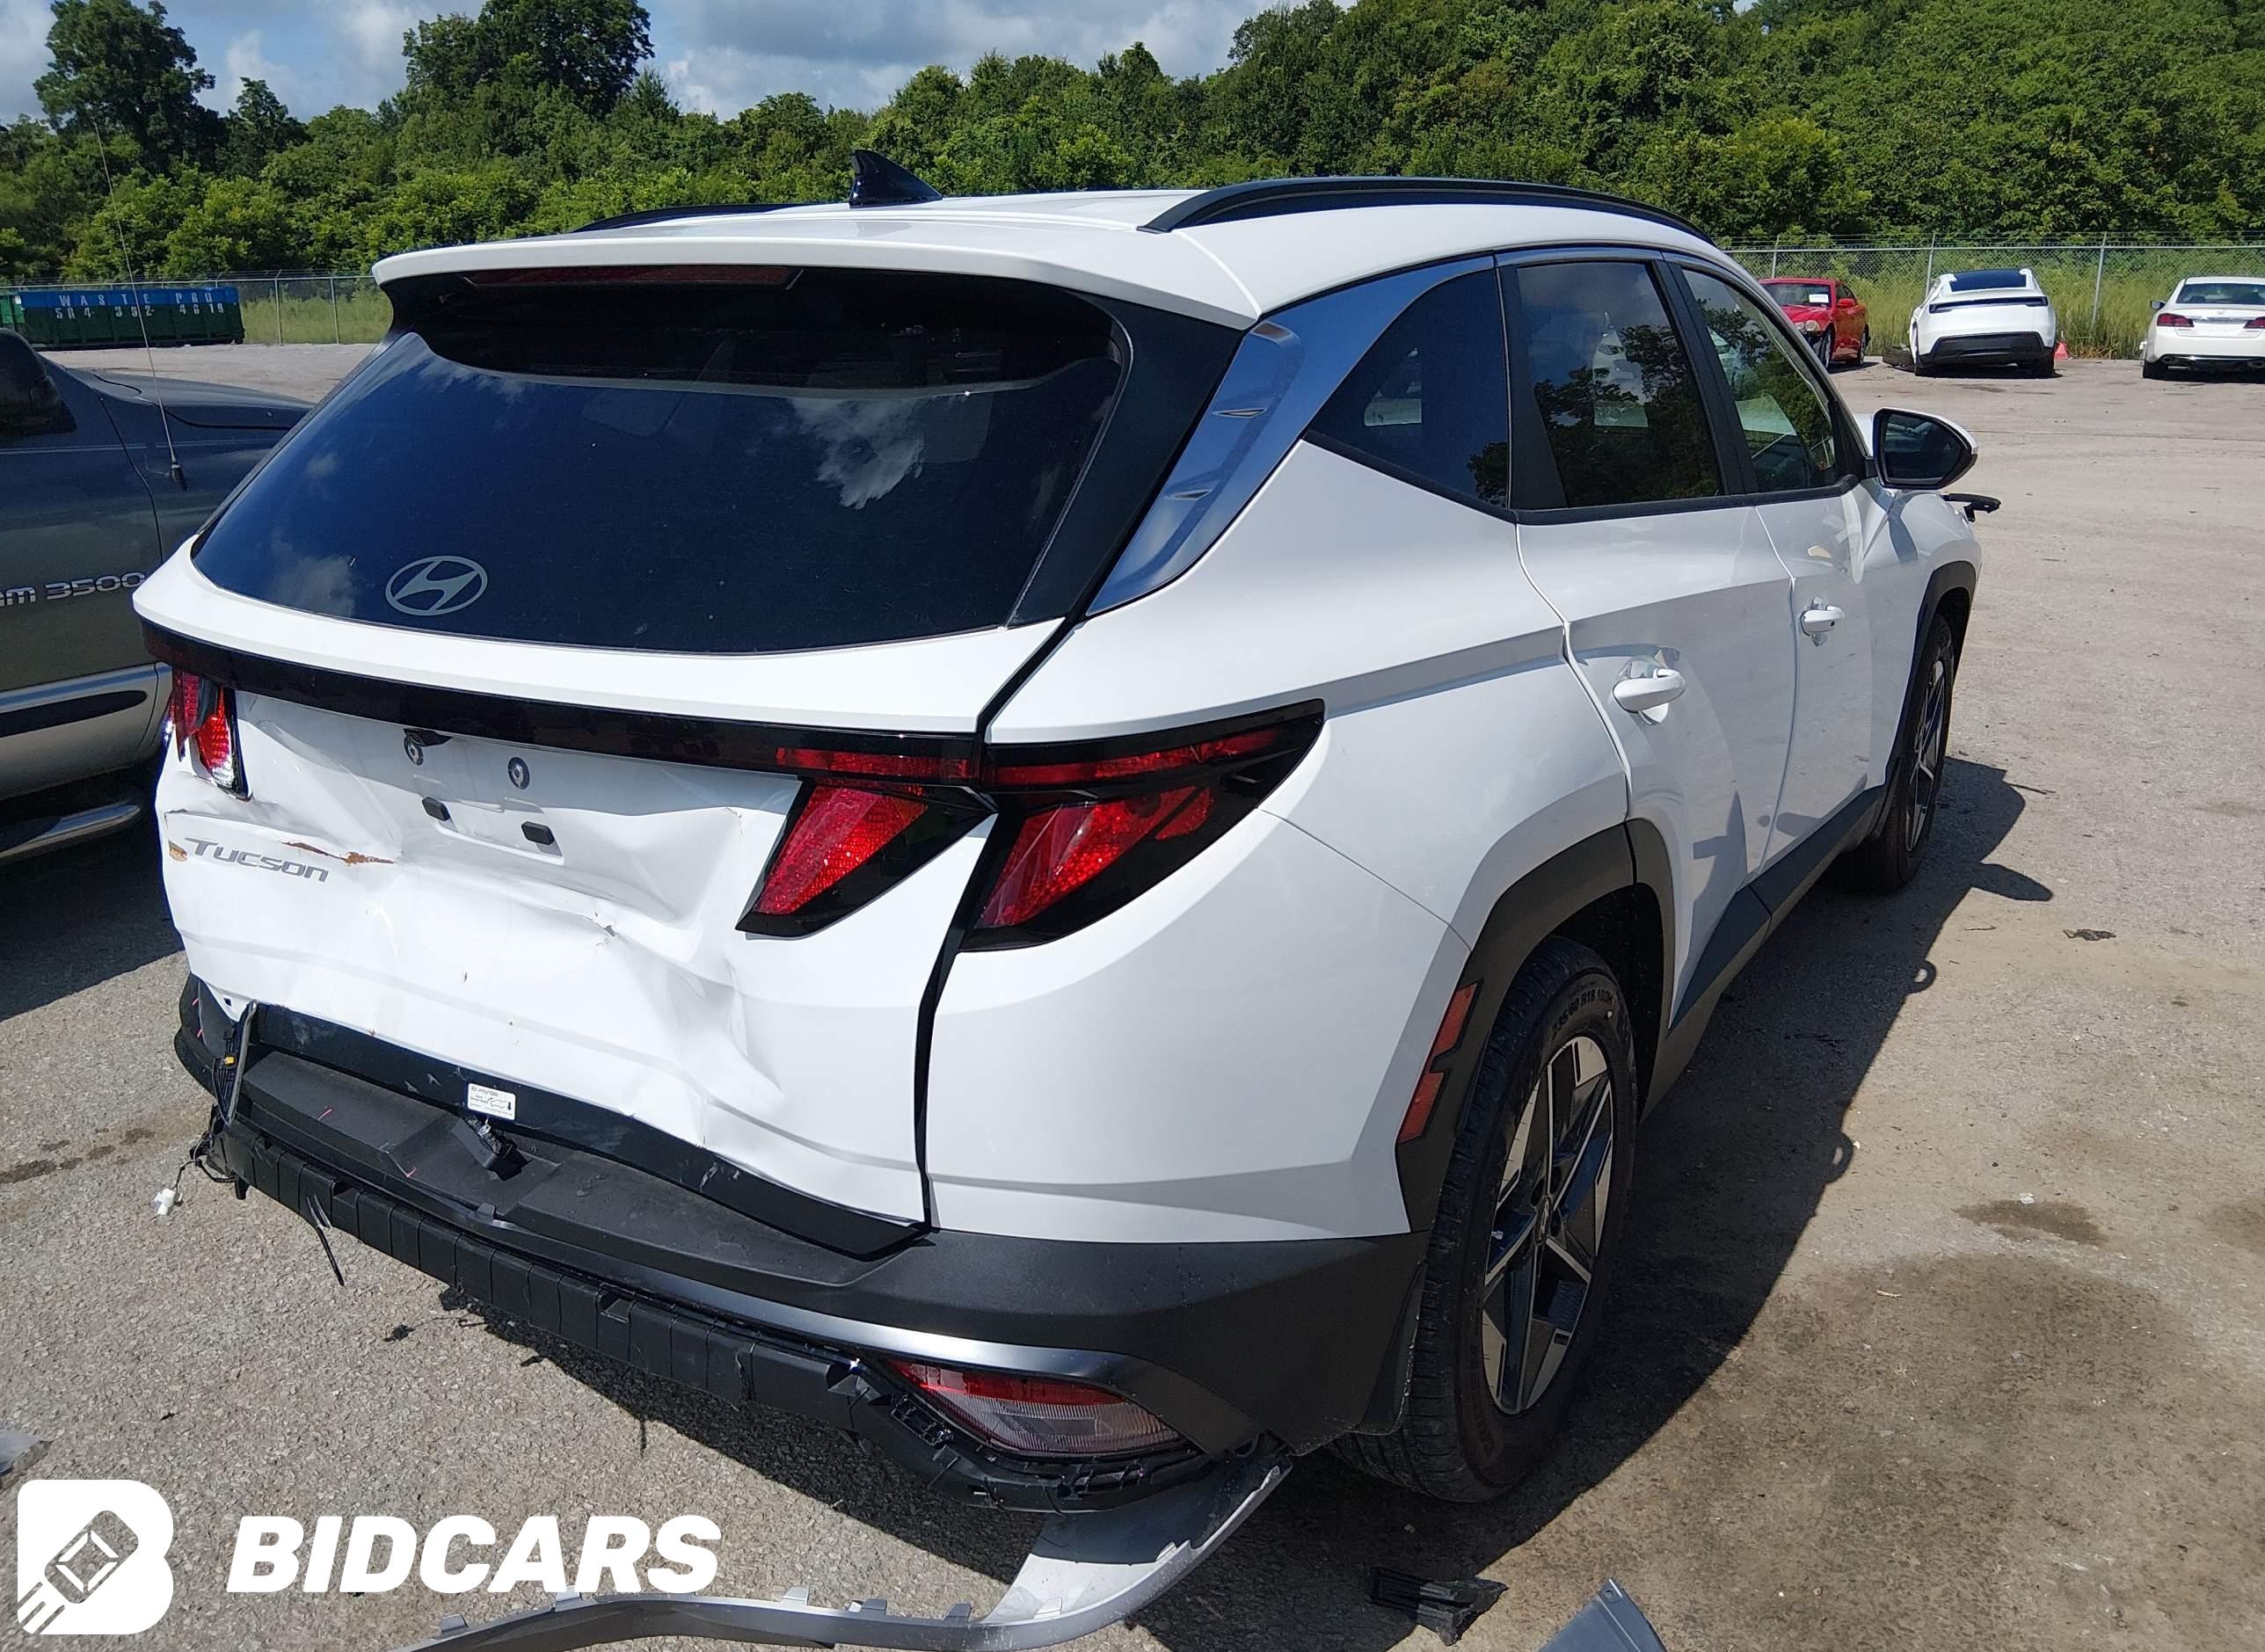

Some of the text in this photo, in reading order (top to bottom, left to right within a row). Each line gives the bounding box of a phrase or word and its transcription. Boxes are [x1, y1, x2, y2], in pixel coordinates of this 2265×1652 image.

[58, 292, 213, 308] WASTE PRO
[44, 571, 146, 600] 3500
